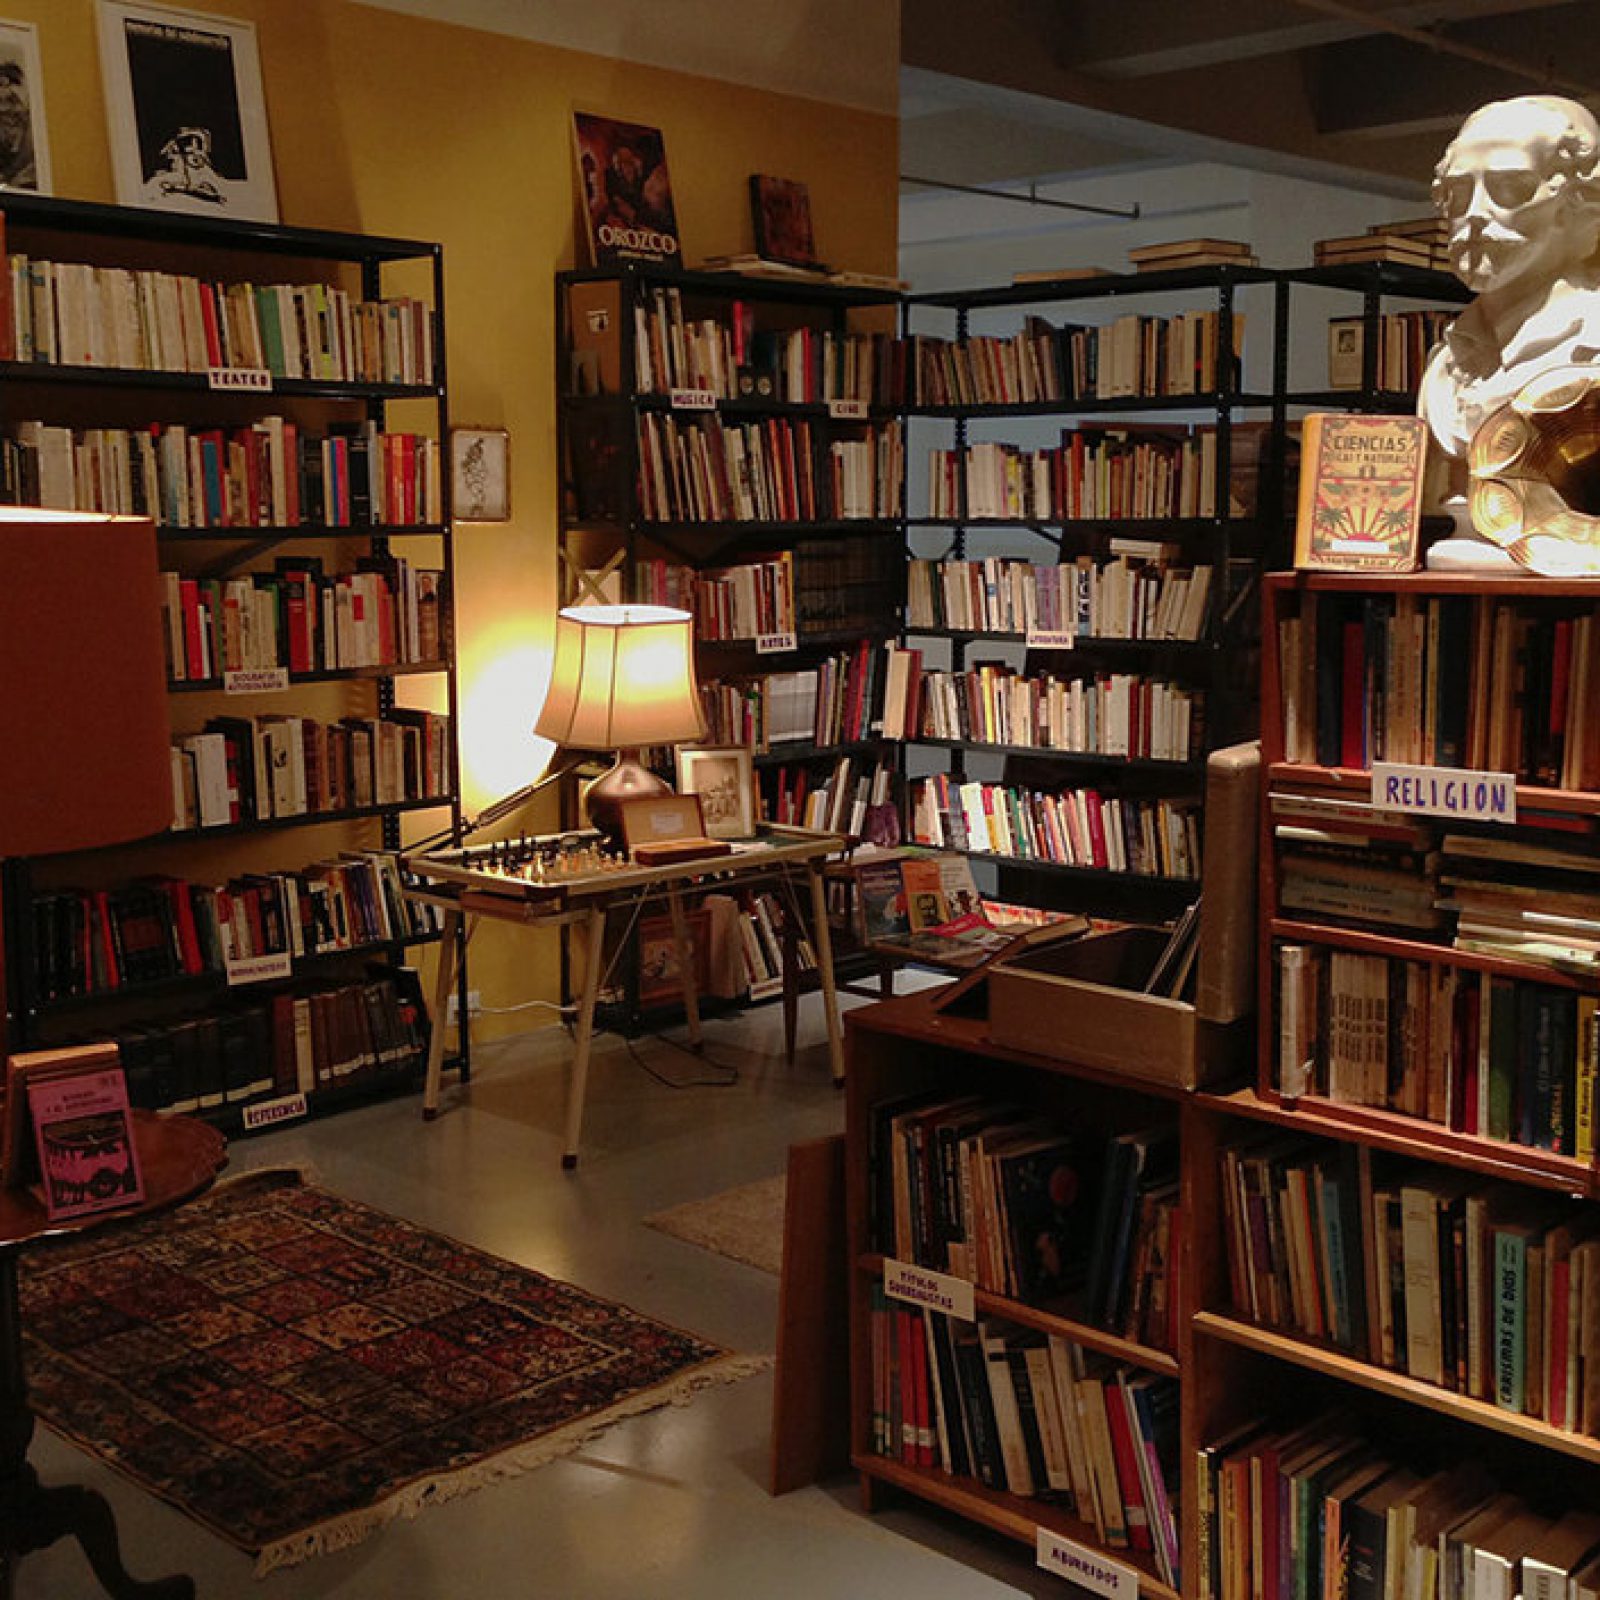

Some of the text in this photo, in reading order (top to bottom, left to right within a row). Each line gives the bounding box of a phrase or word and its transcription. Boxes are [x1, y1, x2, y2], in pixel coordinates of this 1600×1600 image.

[598, 224, 678, 254] OROZCO
[1333, 434, 1407, 452] CIENCIAS
[1501, 1267, 1517, 1301] DIOS
[1501, 1305, 1515, 1326] DE
[1499, 1328, 1514, 1404] CARISMAS
[1051, 1547, 1119, 1590] ABURRIDOS
